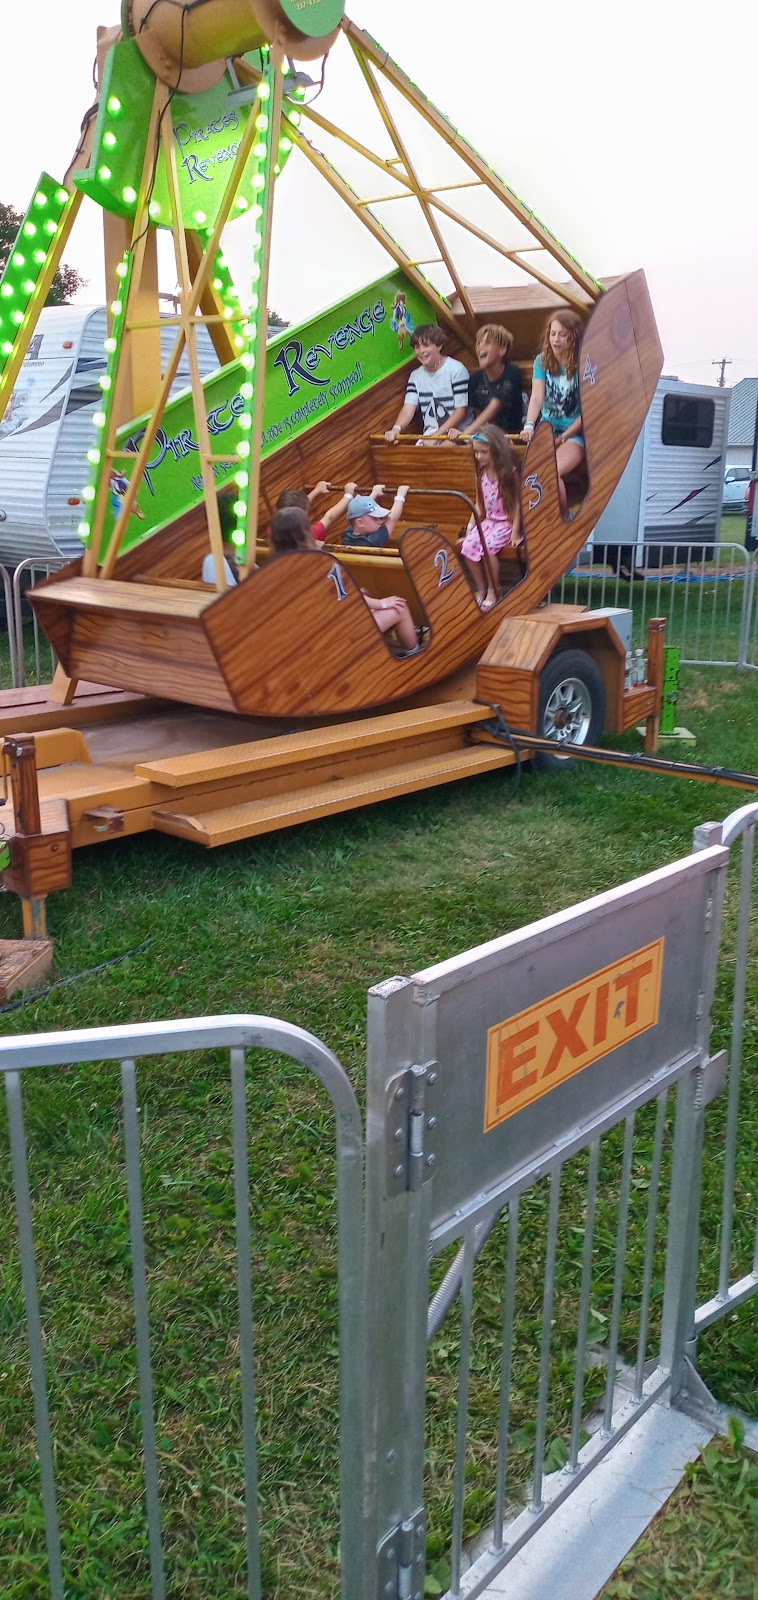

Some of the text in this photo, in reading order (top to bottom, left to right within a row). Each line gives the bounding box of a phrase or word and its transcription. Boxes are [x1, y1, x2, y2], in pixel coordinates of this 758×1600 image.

[583, 354, 598, 385] 4
[525, 474, 543, 511] 3
[327, 563, 348, 601] 1
[433, 549, 455, 587] 2
[496, 958, 653, 1107] EXIT
